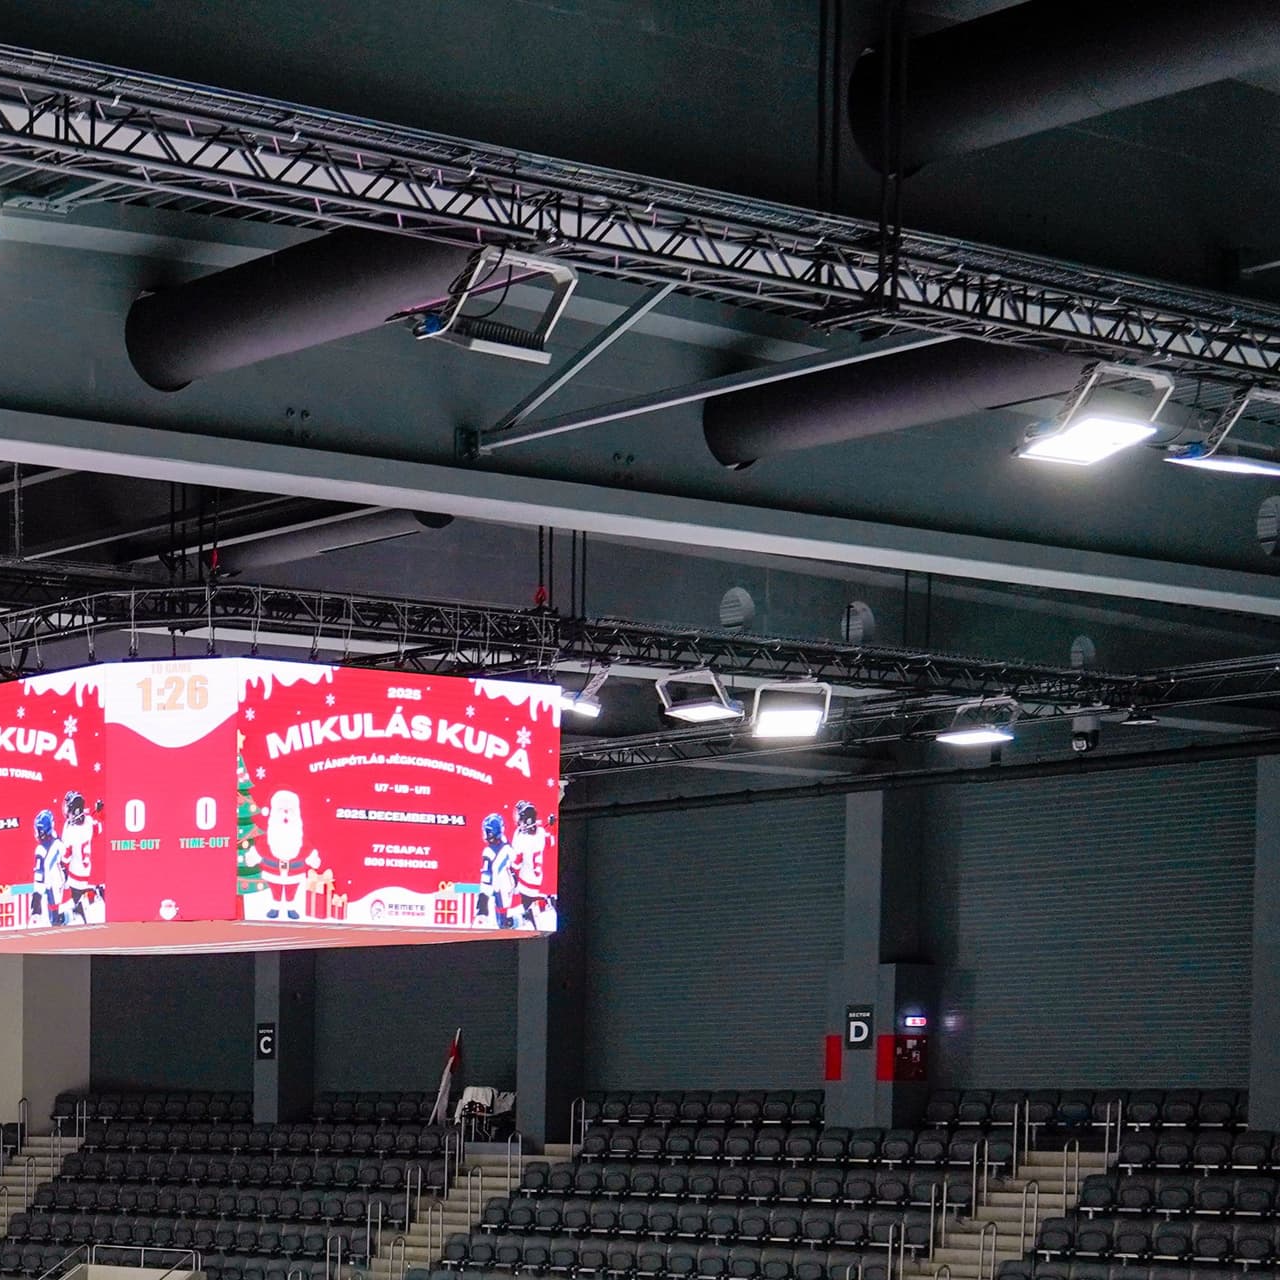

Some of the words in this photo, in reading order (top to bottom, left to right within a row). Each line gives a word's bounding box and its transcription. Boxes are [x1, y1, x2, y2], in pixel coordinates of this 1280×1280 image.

[136, 674, 209, 712] 1:26
[387, 687, 422, 700] 2025
[265, 706, 433, 760] MIKULÁS
[10, 768, 43, 782] TORNA
[309, 753, 385, 773] UTÁNPÓTLÁS
[456, 765, 493, 785] TORNA
[125, 799, 146, 833] 0
[196, 796, 217, 830] 0
[368, 811, 435, 824] DECEMBER
[110, 838, 160, 851] TIME-OUT
[179, 837, 230, 849] TIME-OUT
[385, 845, 431, 855] CSAPAT
[850, 1021, 869, 1042] D
[260, 1036, 272, 1054] C
